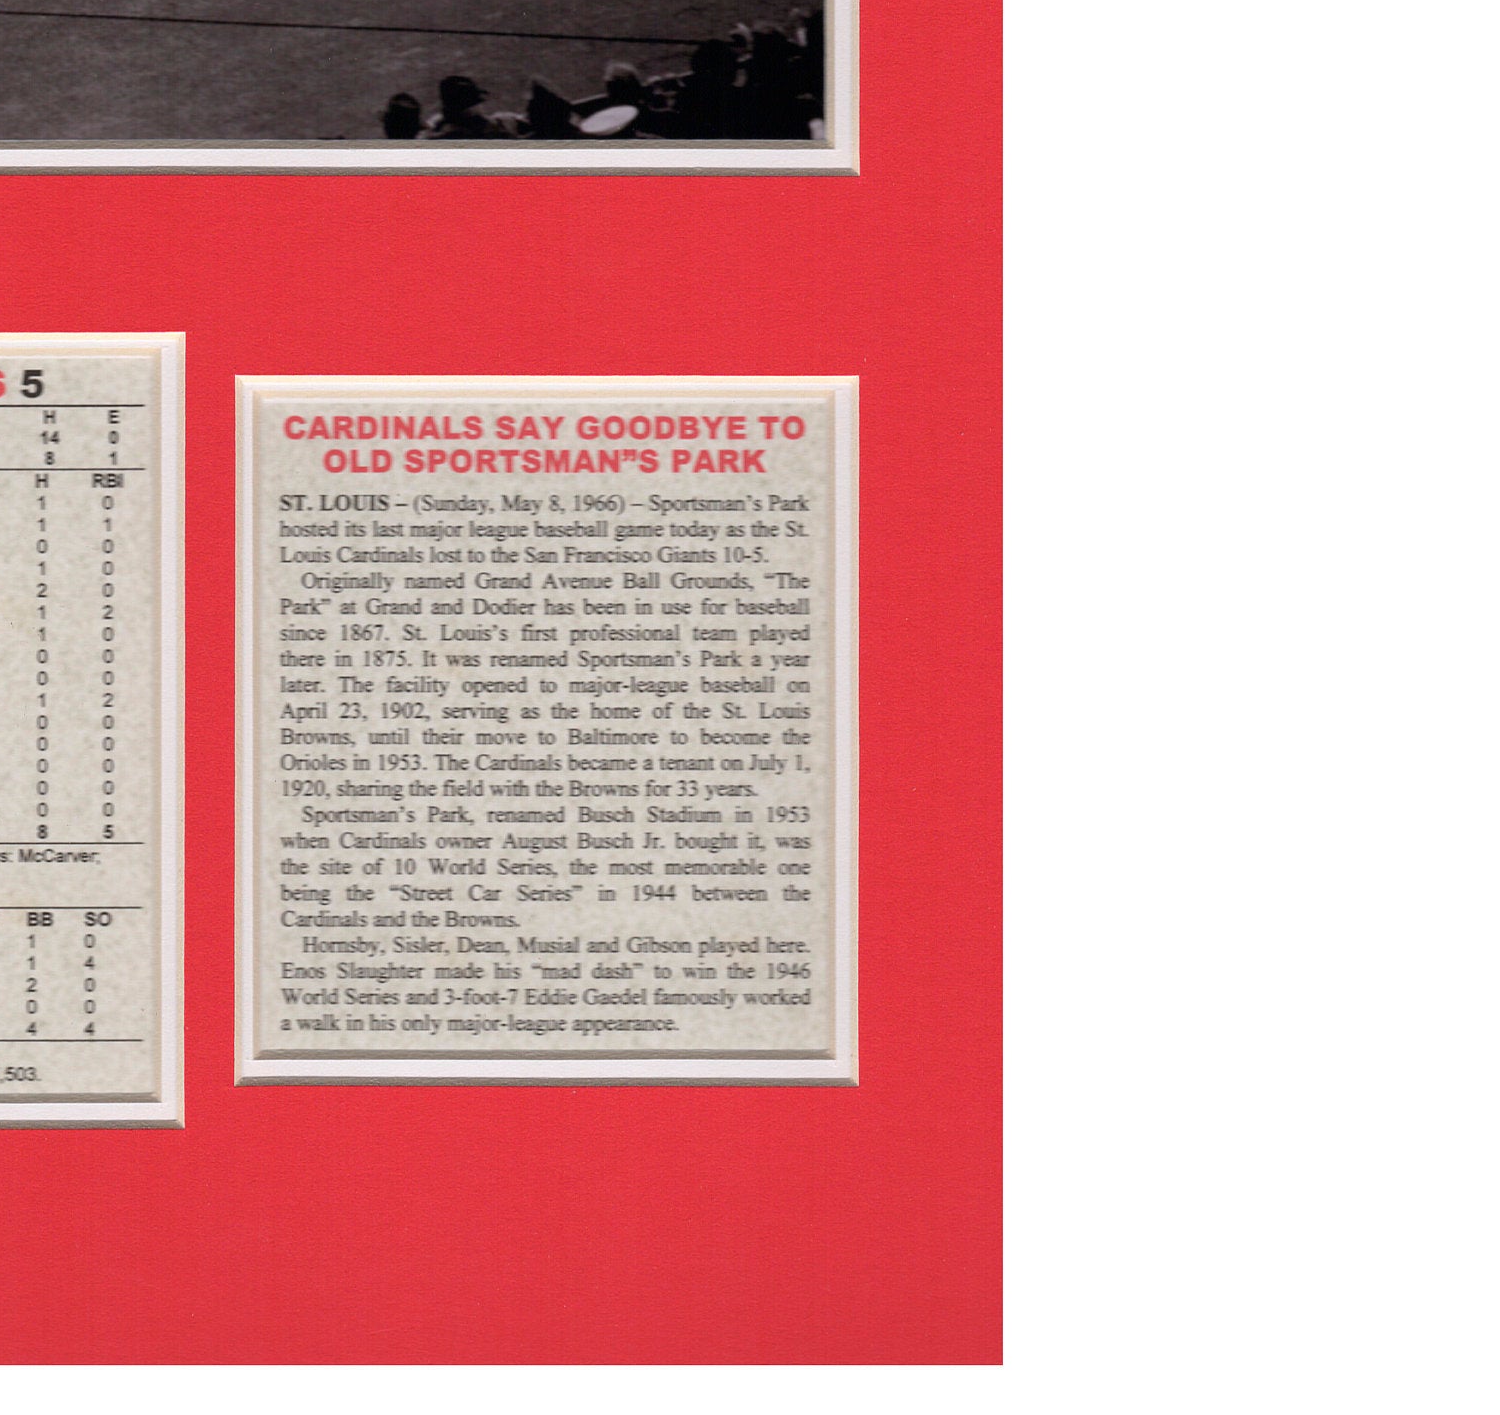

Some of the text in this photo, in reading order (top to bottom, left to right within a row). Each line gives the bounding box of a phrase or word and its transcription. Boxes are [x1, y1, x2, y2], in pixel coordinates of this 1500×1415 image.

[20, 370, 44, 398] 5
[42, 409, 57, 425] H
[107, 409, 121, 425] E
[284, 416, 805, 440] CARDINALS SAY GOODBYE TO
[324, 449, 392, 473] OLD
[672, 450, 766, 473] PARK
[278, 494, 314, 512] ST.
[318, 494, 391, 512] LOUIS
[412, 494, 495, 516] (Sunday,
[501, 494, 544, 516] May
[548, 494, 566, 513] 8,
[573, 494, 626, 515] 1966)
[648, 494, 763, 517] Sportsman’s
[767, 494, 810, 512] Park
[280, 624, 810, 646] since 1867. St. Louis’s first professional team played
[302, 806, 810, 827] Sportsman’s Park, renamed Busch Stadium in 1953
[303, 936, 810, 956] Hornsby, Sisler, Dean, Musial and Gibson played here.
